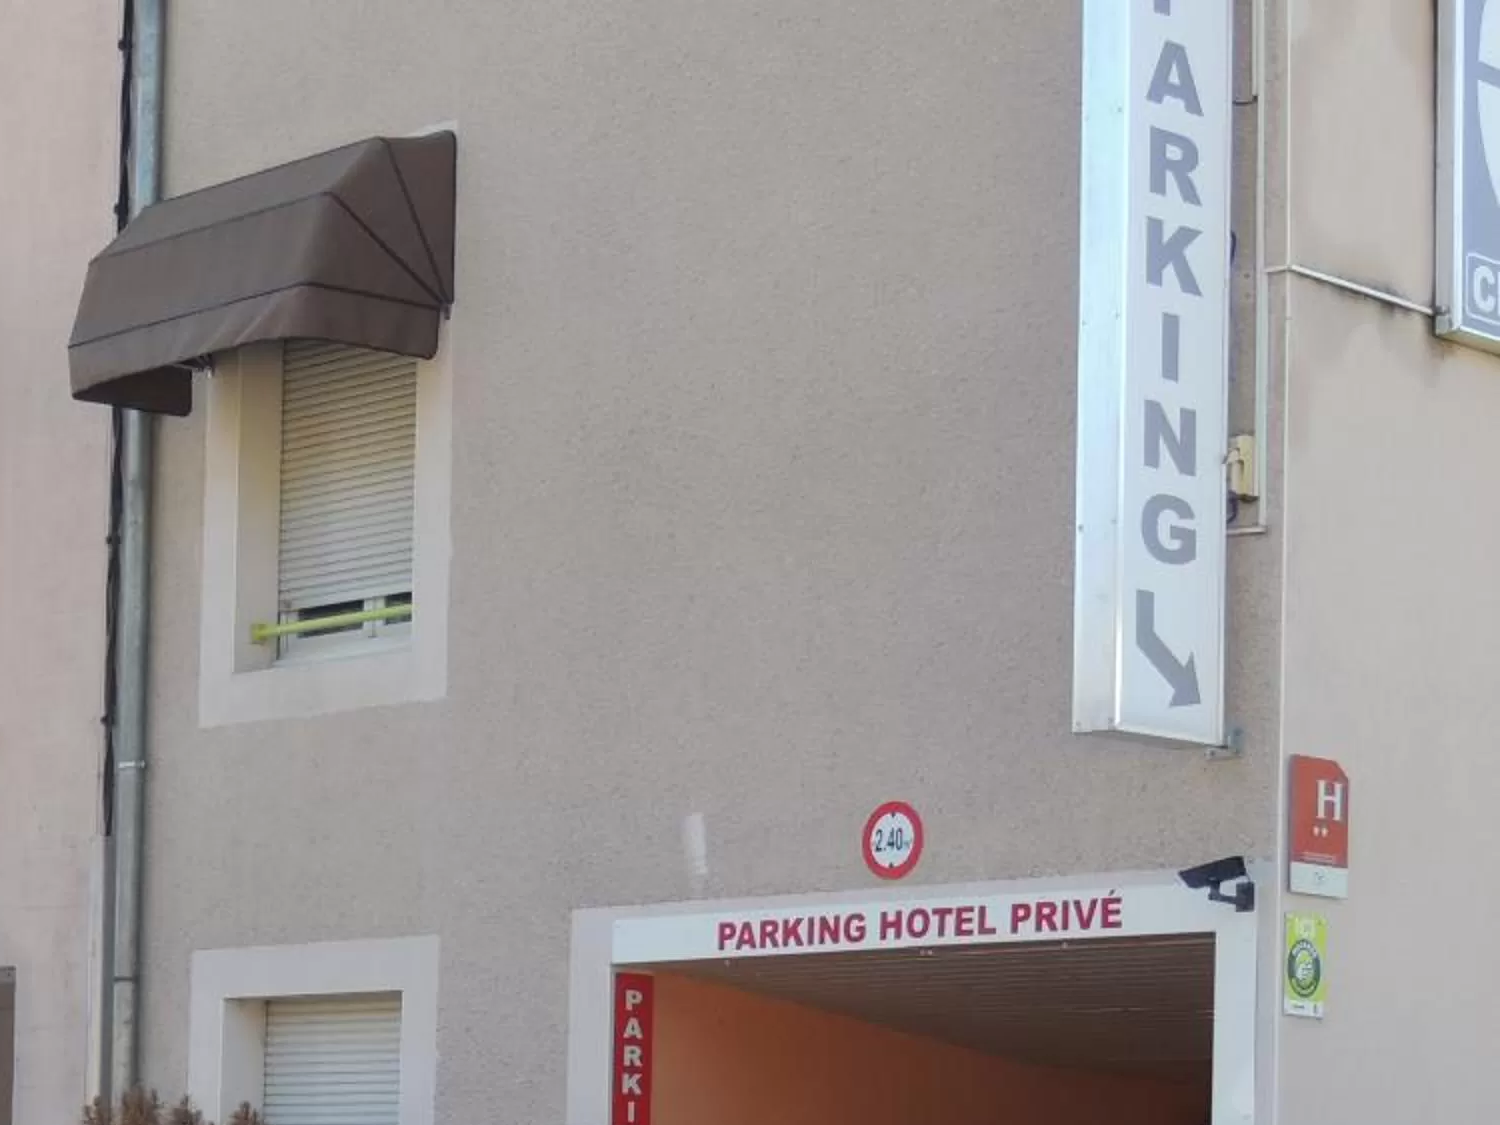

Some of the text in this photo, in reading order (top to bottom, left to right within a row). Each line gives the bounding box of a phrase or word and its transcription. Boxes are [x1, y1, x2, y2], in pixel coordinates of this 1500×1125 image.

[1140, 0, 1204, 565] ARKING
[1473, 264, 1500, 317] C
[1316, 779, 1343, 822] H
[717, 889, 1123, 951] PARKING HOTEL PRIVÉ
